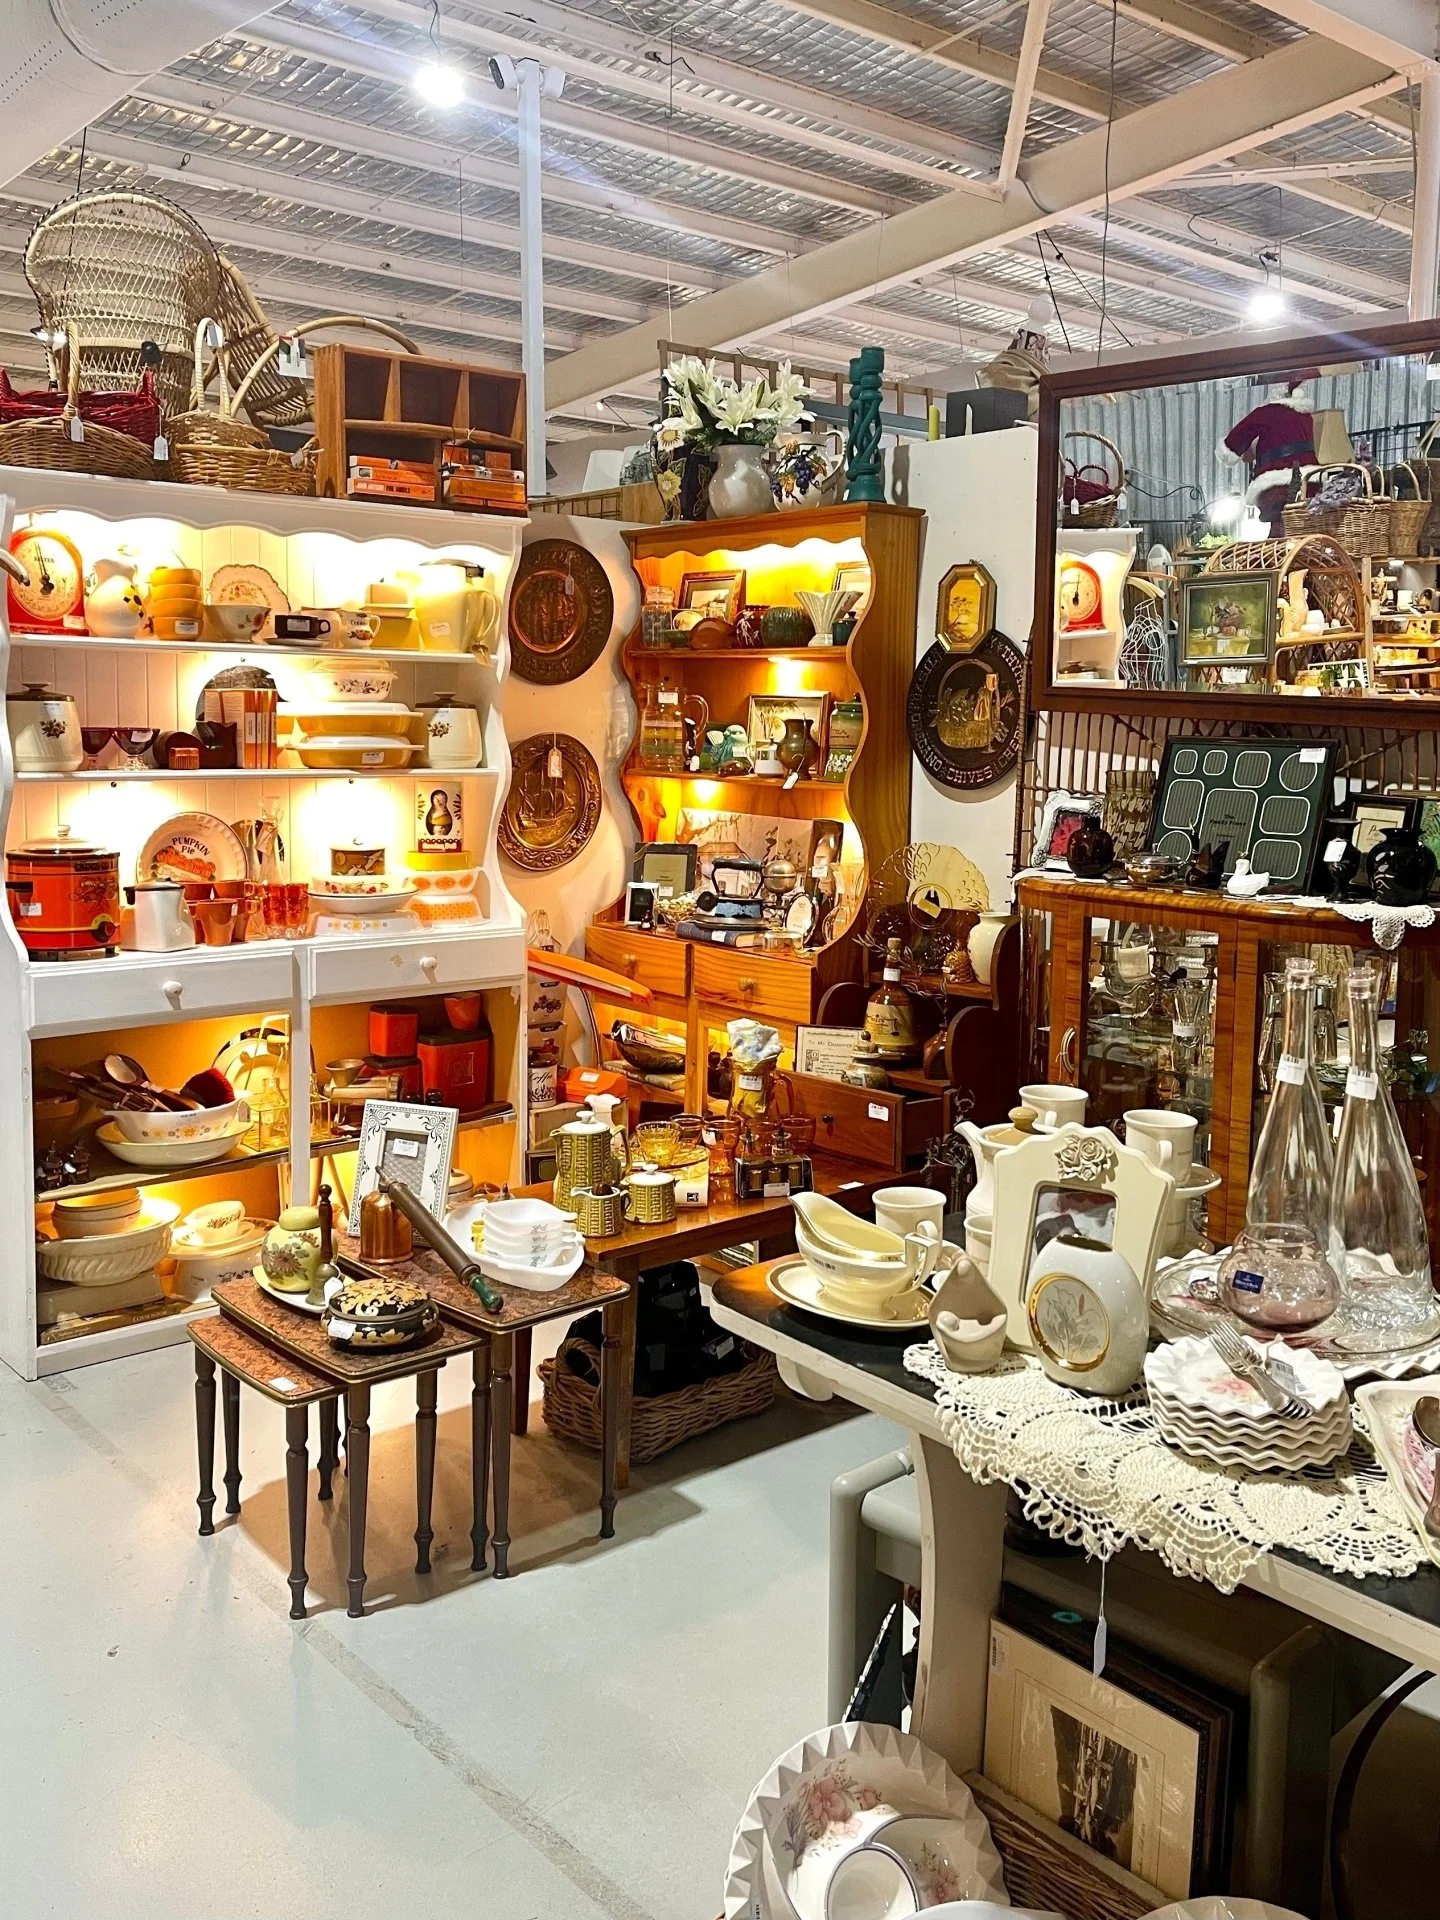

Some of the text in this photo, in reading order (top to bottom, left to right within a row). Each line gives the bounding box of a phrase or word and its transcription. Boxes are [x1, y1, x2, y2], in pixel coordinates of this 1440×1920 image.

[946, 765, 993, 784] CHIVES
[171, 836, 211, 857] PUMPKIN
[181, 845, 195, 855] Pie
